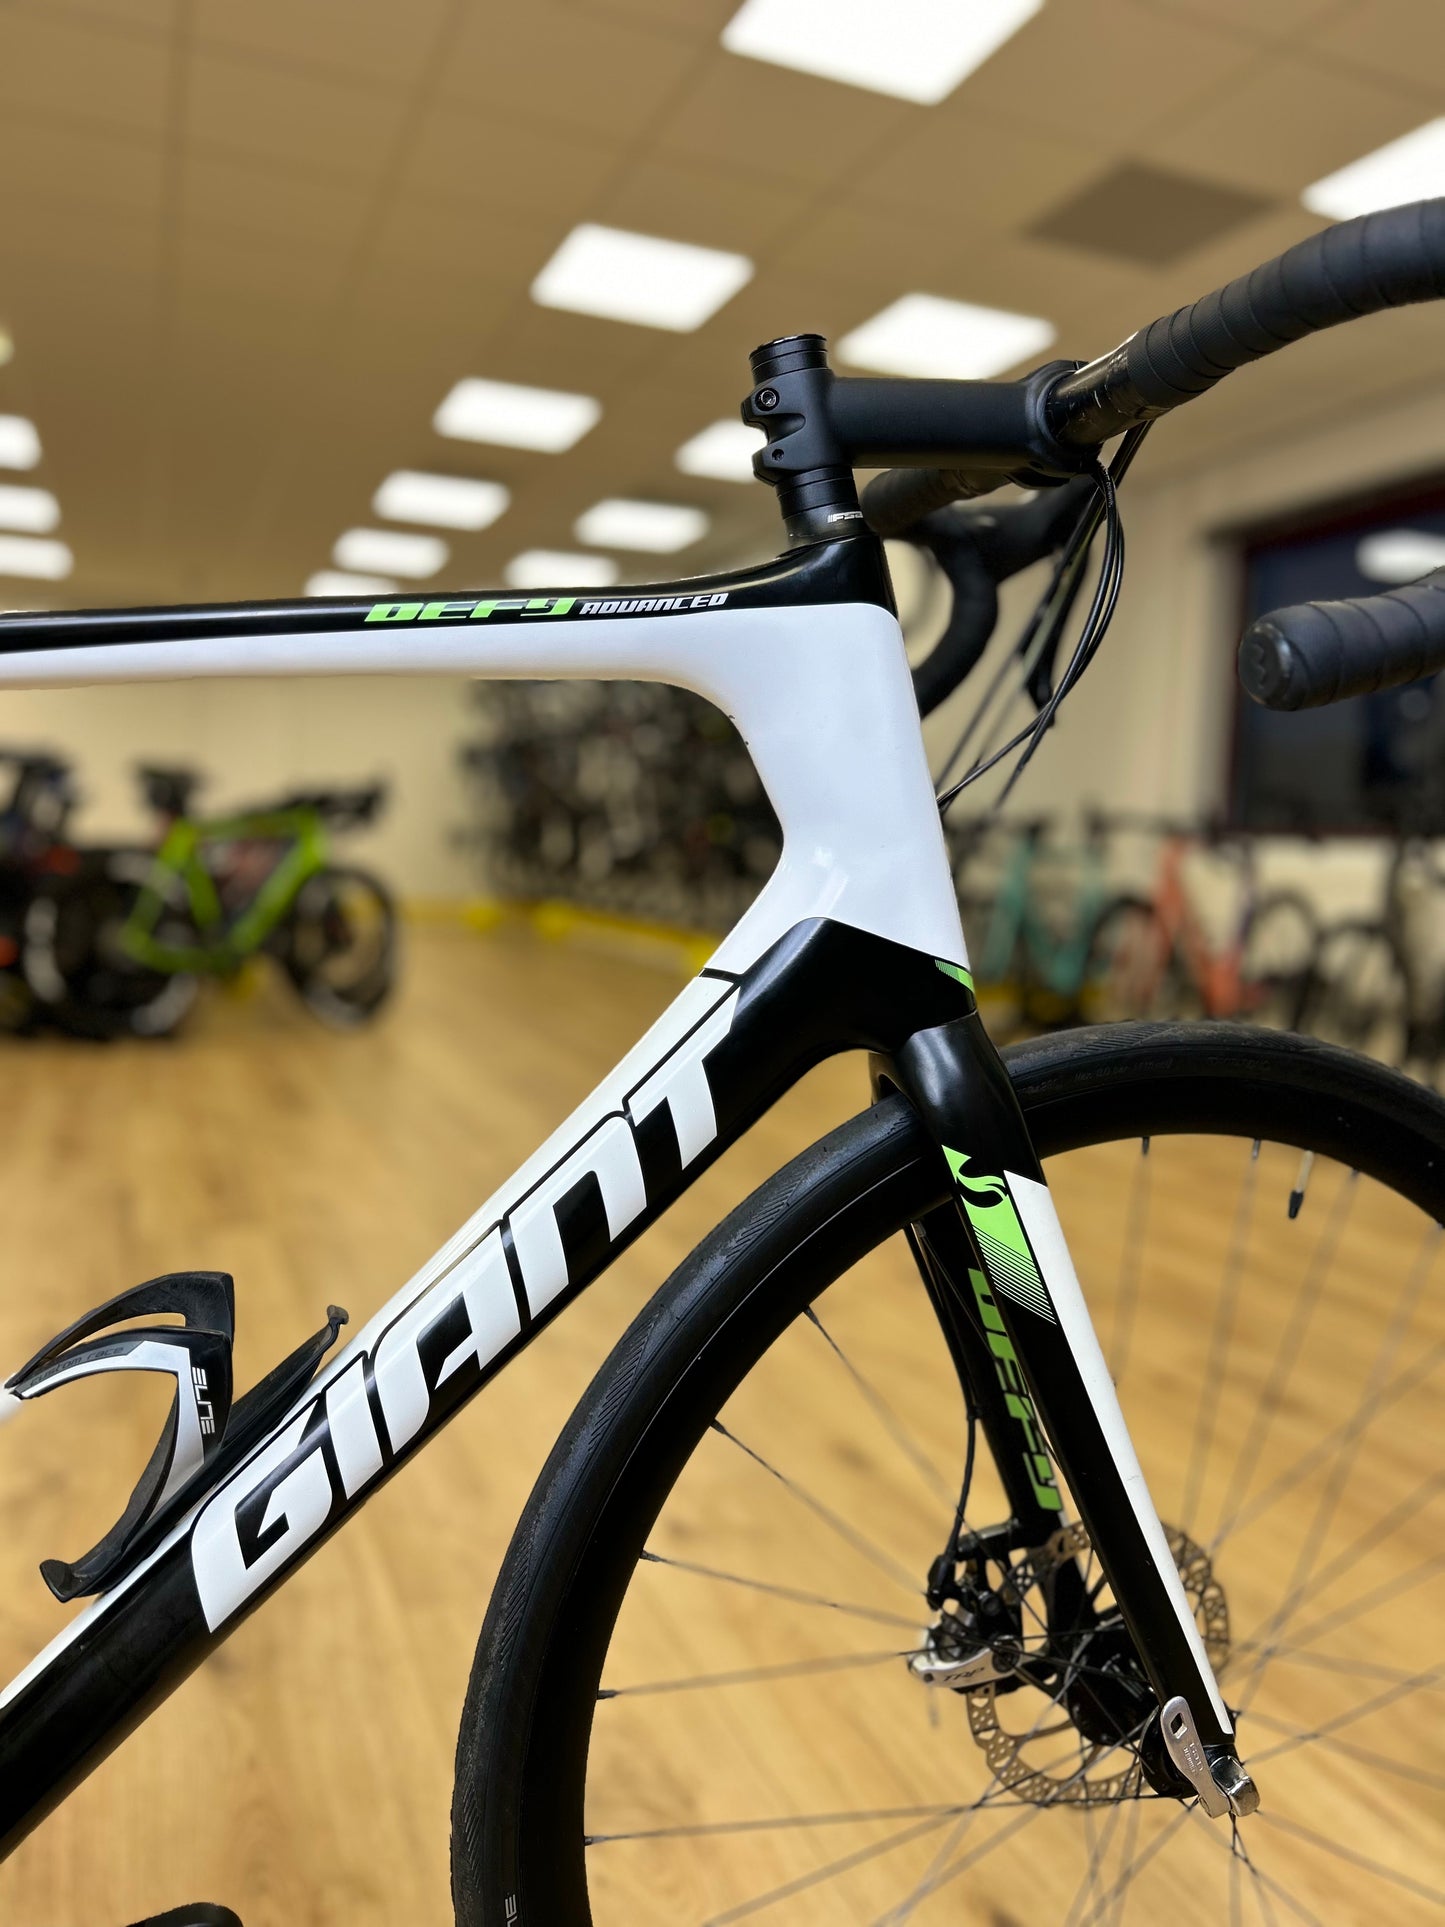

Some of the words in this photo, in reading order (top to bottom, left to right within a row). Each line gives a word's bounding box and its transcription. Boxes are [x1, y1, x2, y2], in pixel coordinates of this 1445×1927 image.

[364, 597, 577, 622] DEFY
[579, 592, 729, 615] ADVANCED
[190, 985, 741, 1633] GIANT
[191, 1366, 216, 1435] ELITE
